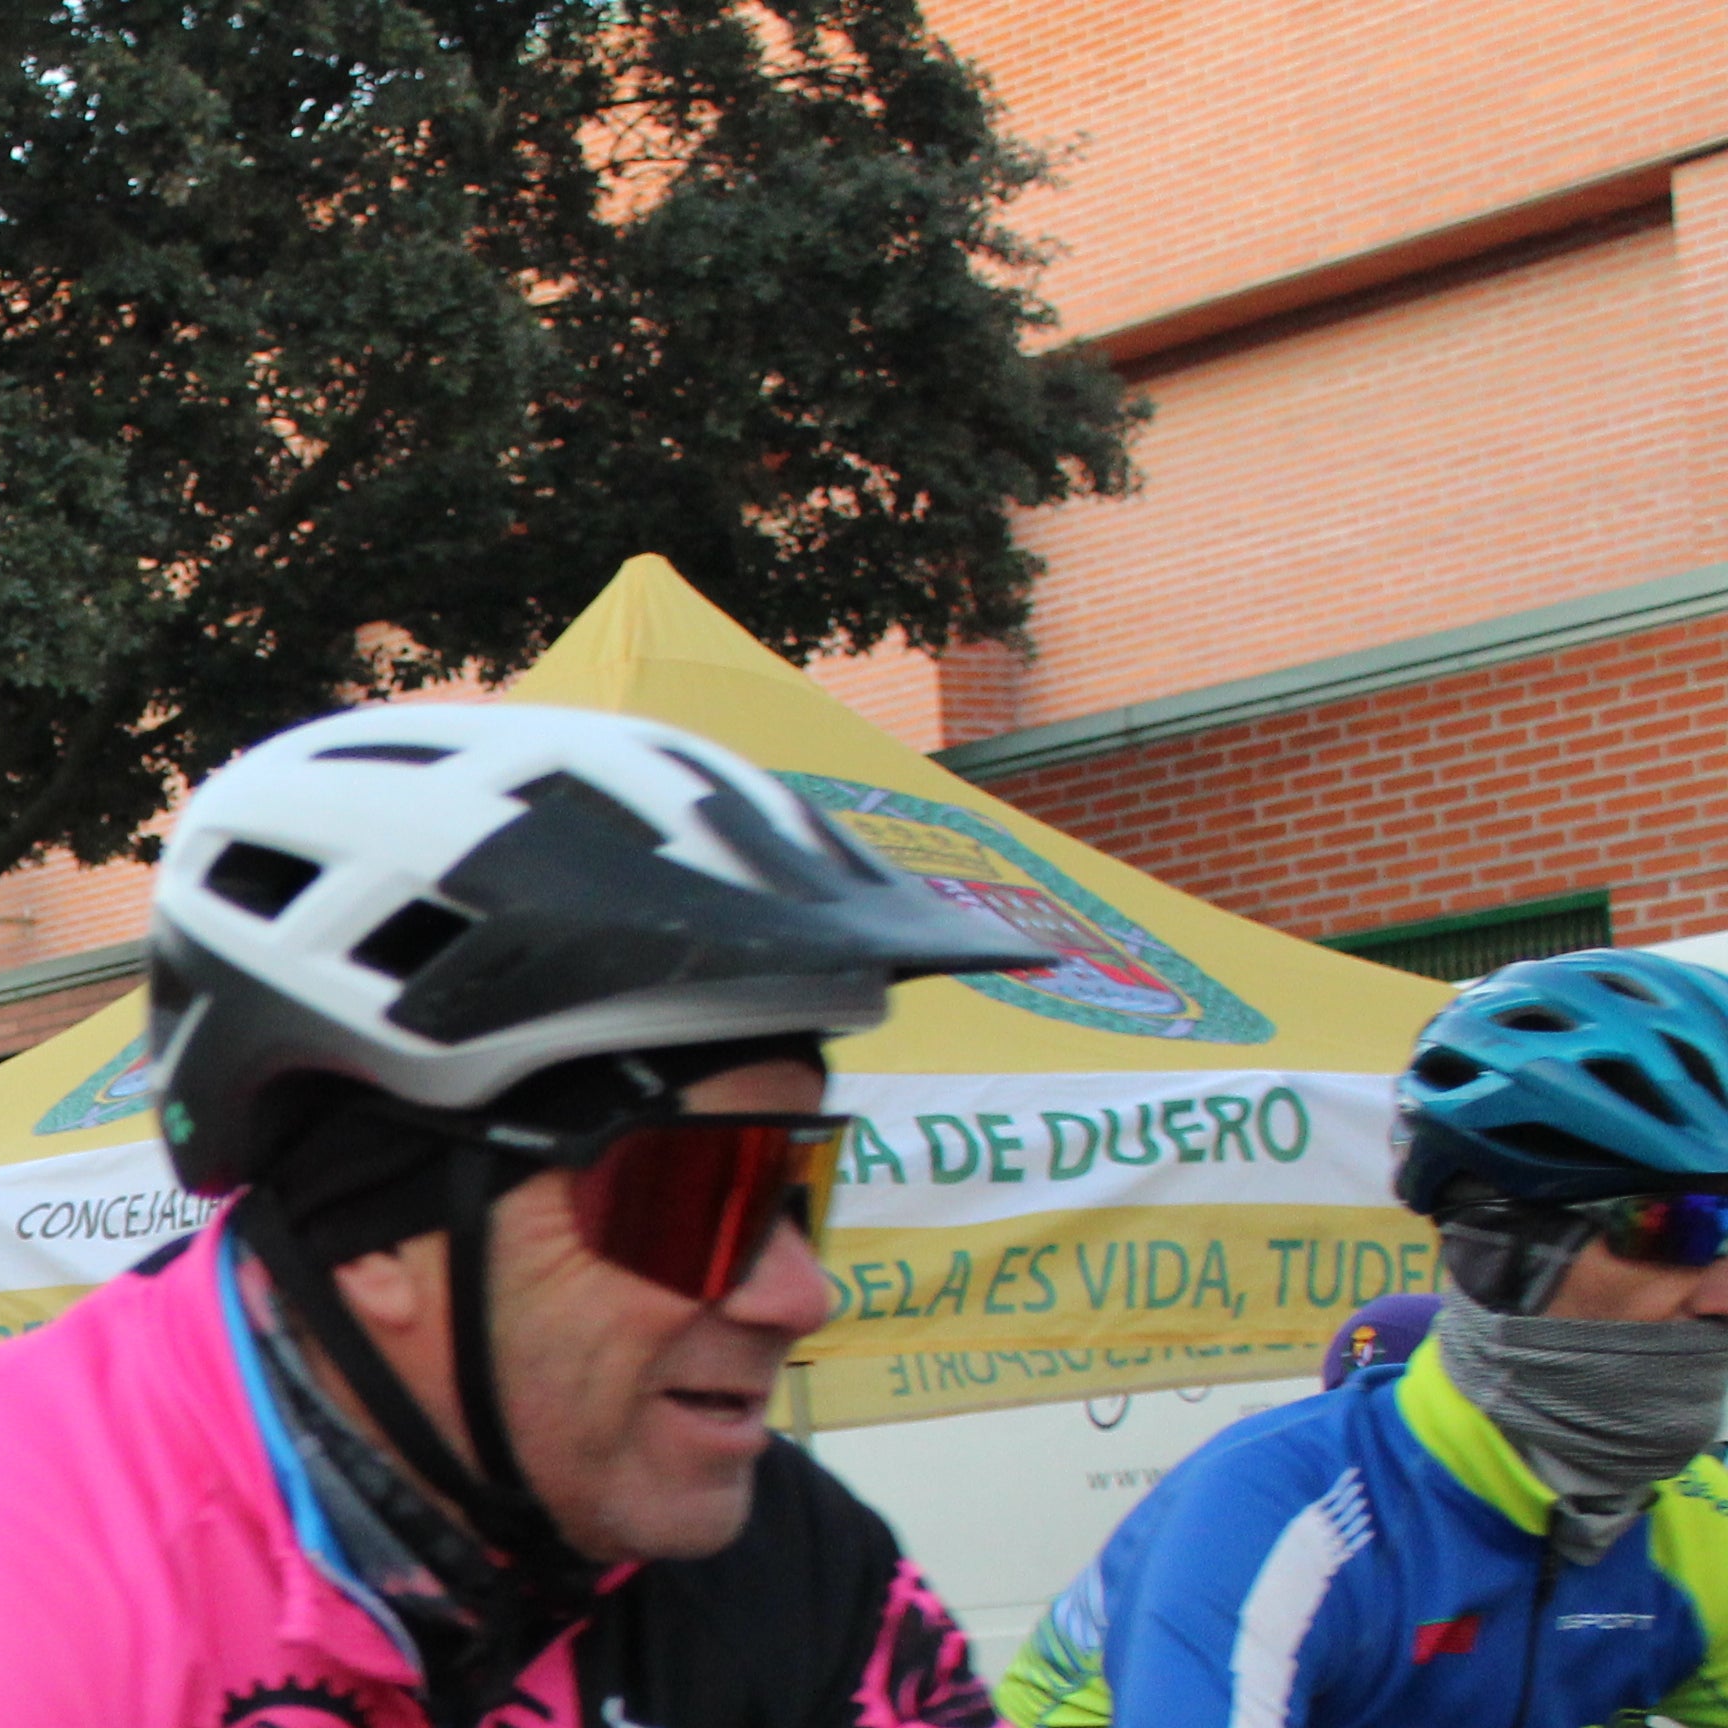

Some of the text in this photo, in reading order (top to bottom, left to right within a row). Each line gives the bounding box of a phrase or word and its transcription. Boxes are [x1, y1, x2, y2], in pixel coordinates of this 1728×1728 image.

[916, 1112, 1025, 1186] DE
[1040, 1086, 1311, 1182] DUERO
[983, 1242, 1059, 1317] ES
[1075, 1237, 1249, 1319] VIDA,
